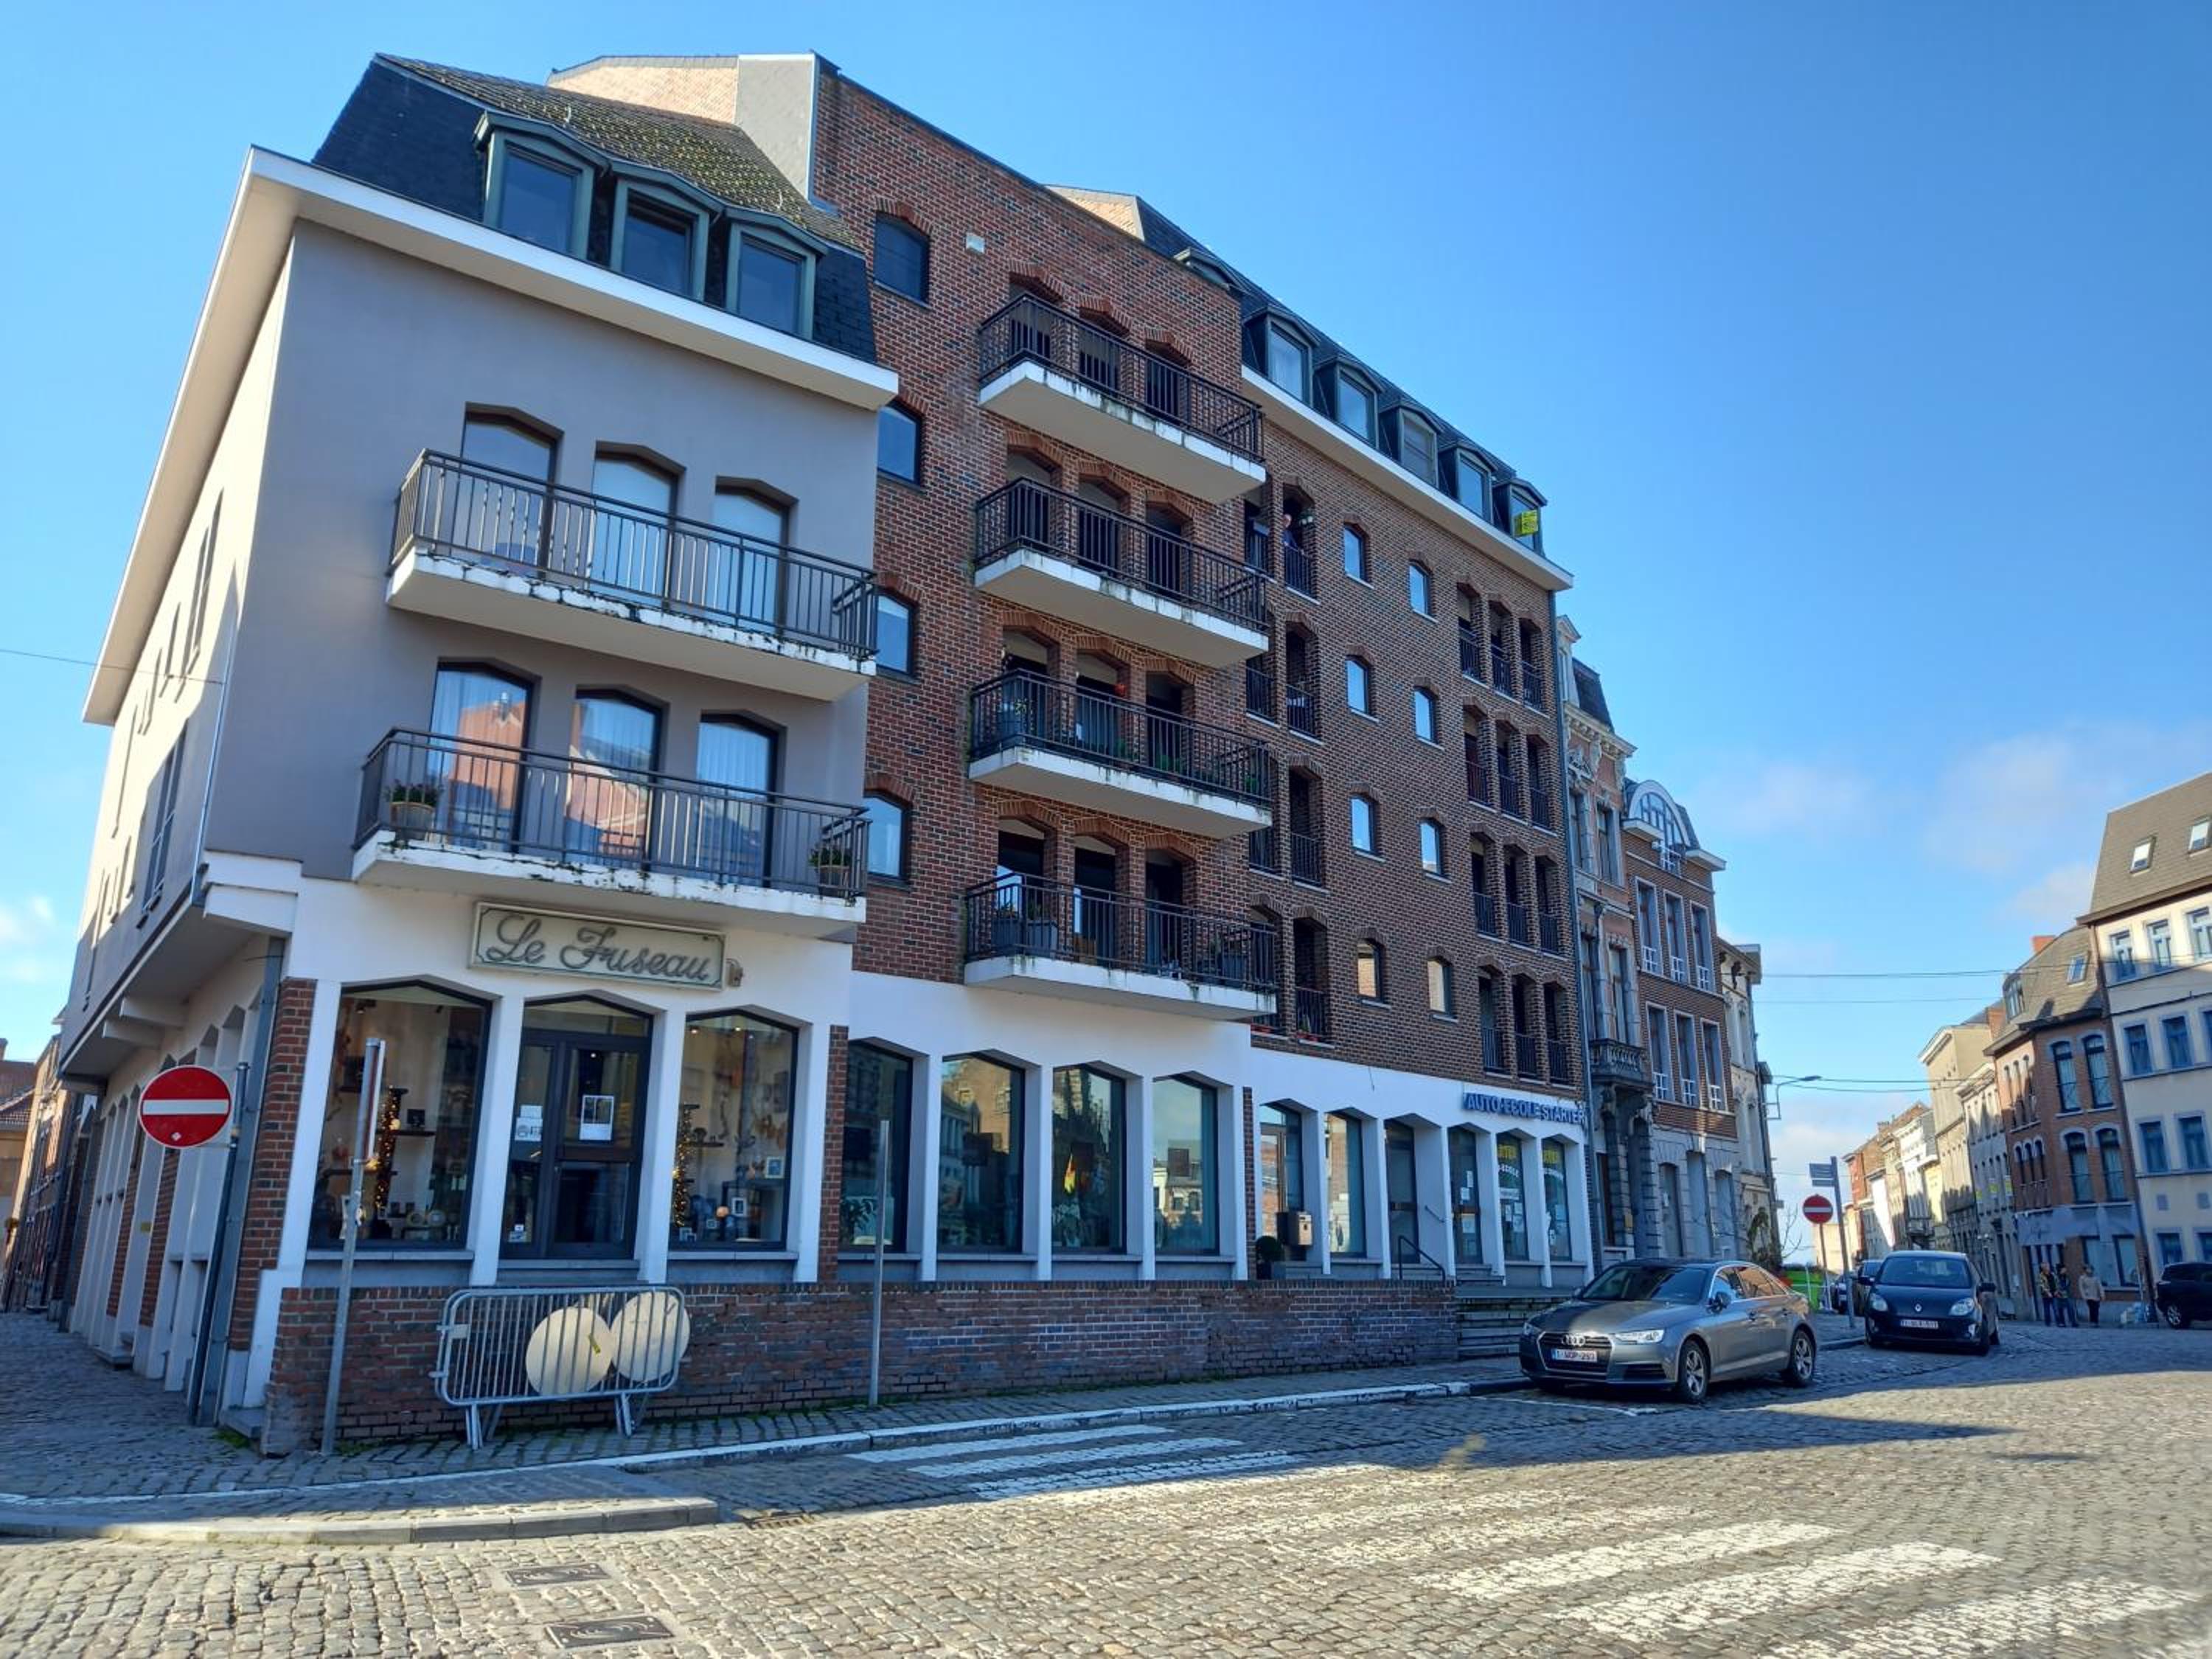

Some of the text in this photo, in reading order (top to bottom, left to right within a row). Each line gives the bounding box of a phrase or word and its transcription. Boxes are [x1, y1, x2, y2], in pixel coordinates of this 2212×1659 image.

[486, 912, 709, 981] Le Fuseau
[1541, 1105, 1585, 1124] STARTER
